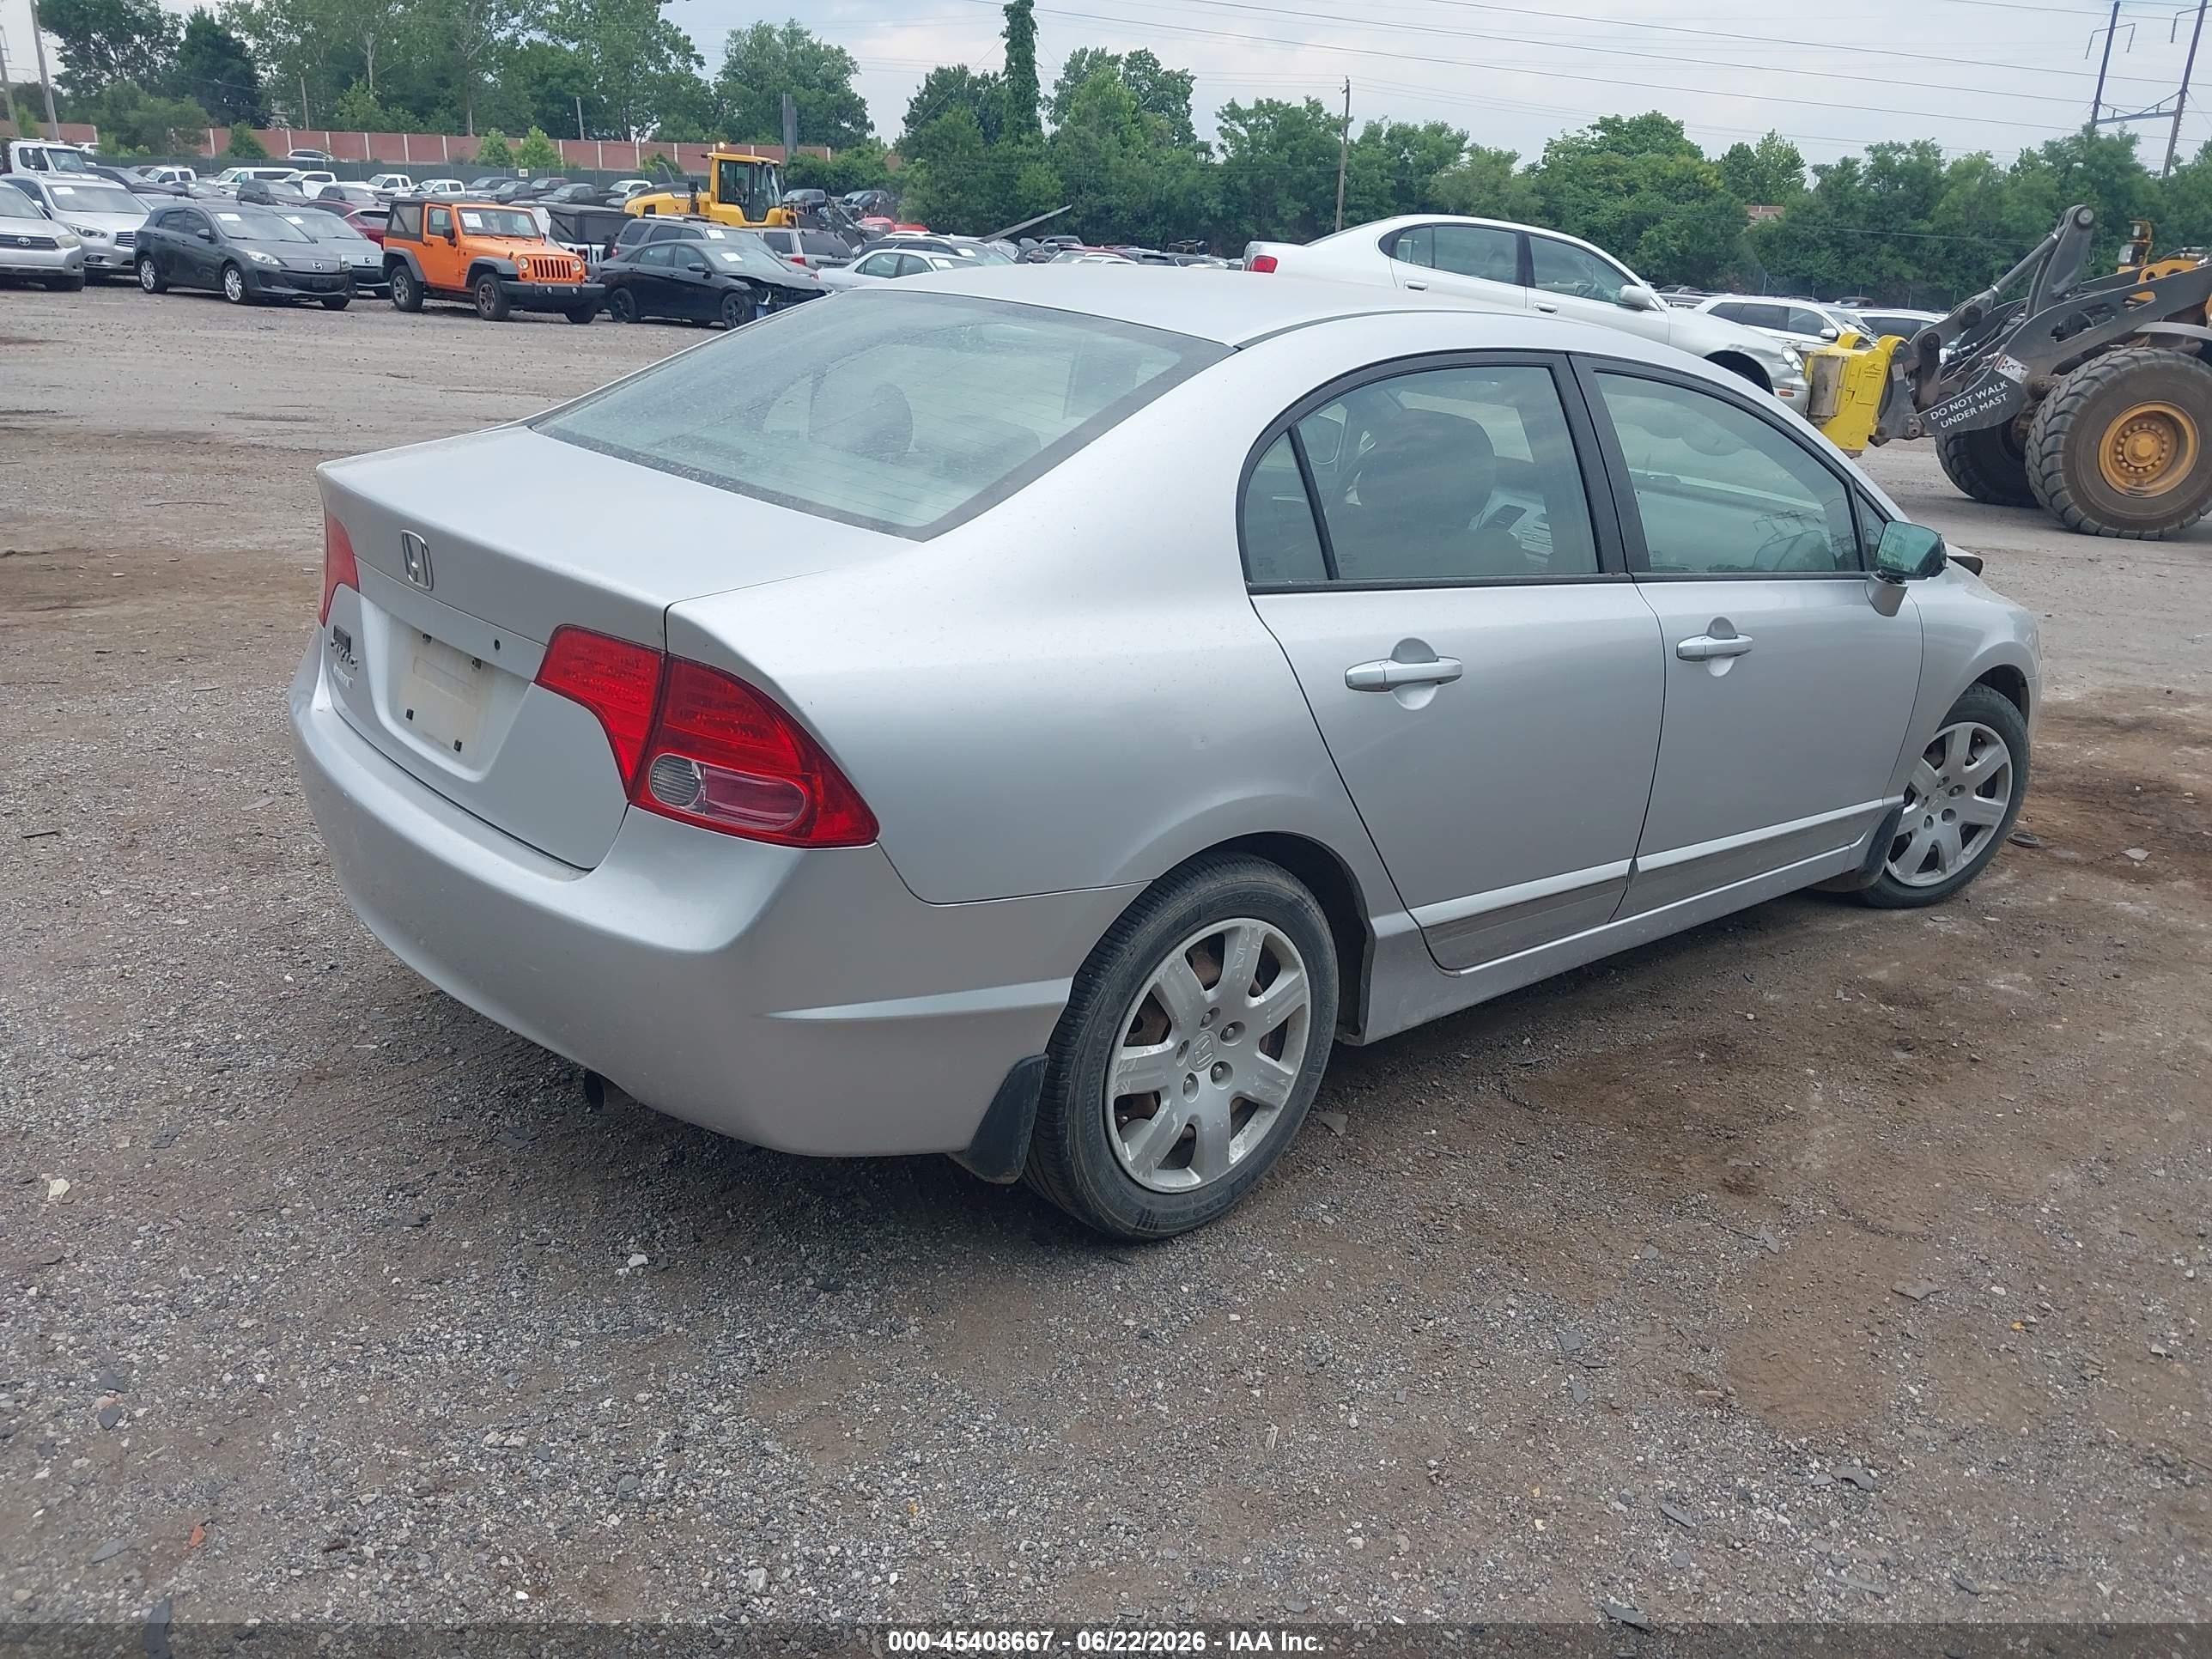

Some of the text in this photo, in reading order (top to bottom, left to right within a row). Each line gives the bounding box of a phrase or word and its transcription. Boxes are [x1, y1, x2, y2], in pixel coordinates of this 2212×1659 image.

[1930, 380, 2008, 421] DO NOT WALK
[1941, 392, 2008, 428] UNDER MAST
